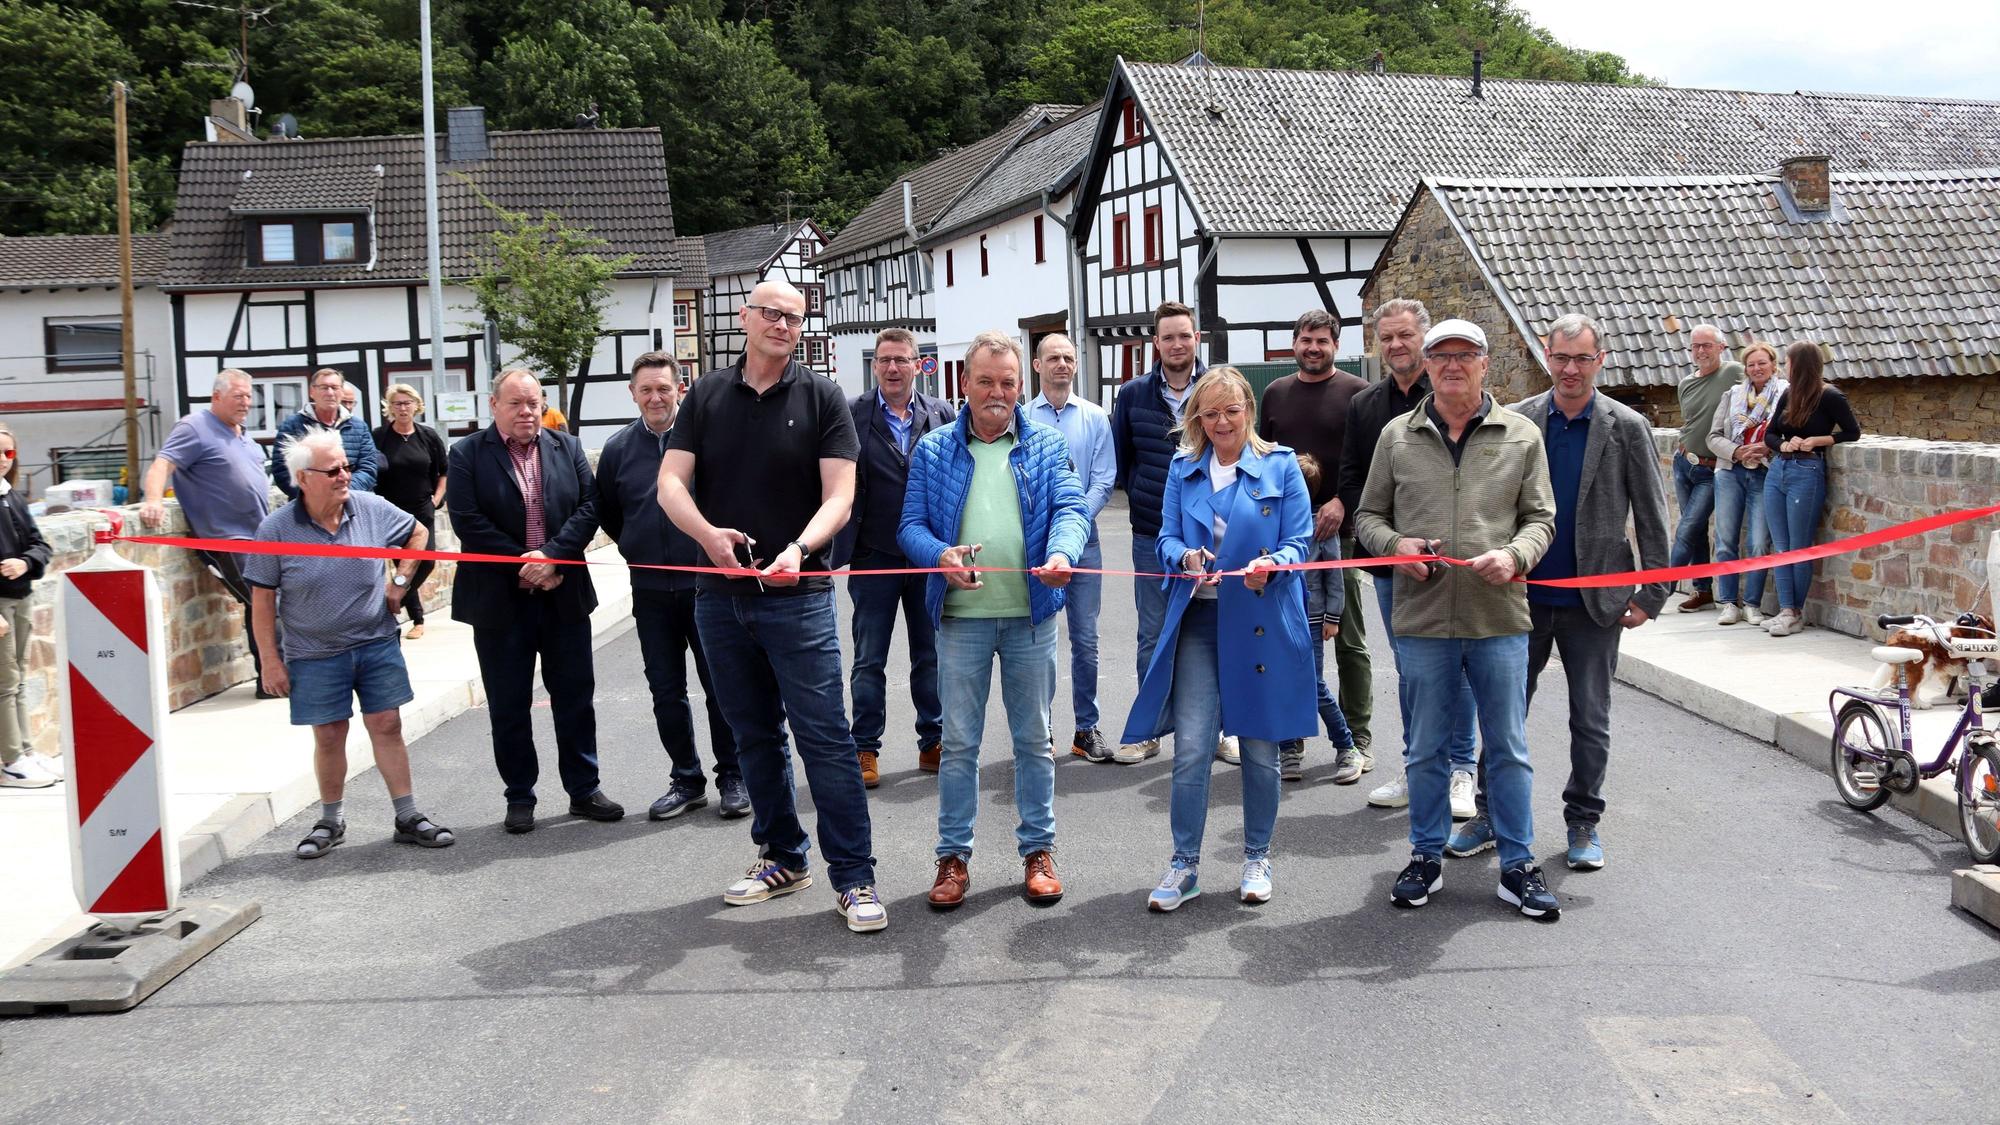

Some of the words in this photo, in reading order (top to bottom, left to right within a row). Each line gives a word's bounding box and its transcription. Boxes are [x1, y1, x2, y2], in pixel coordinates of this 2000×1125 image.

[1961, 644, 1993, 652] PUKY
[97, 650, 116, 658] AVS
[1903, 705, 1911, 732] PUKY
[109, 828, 127, 836] AVS
